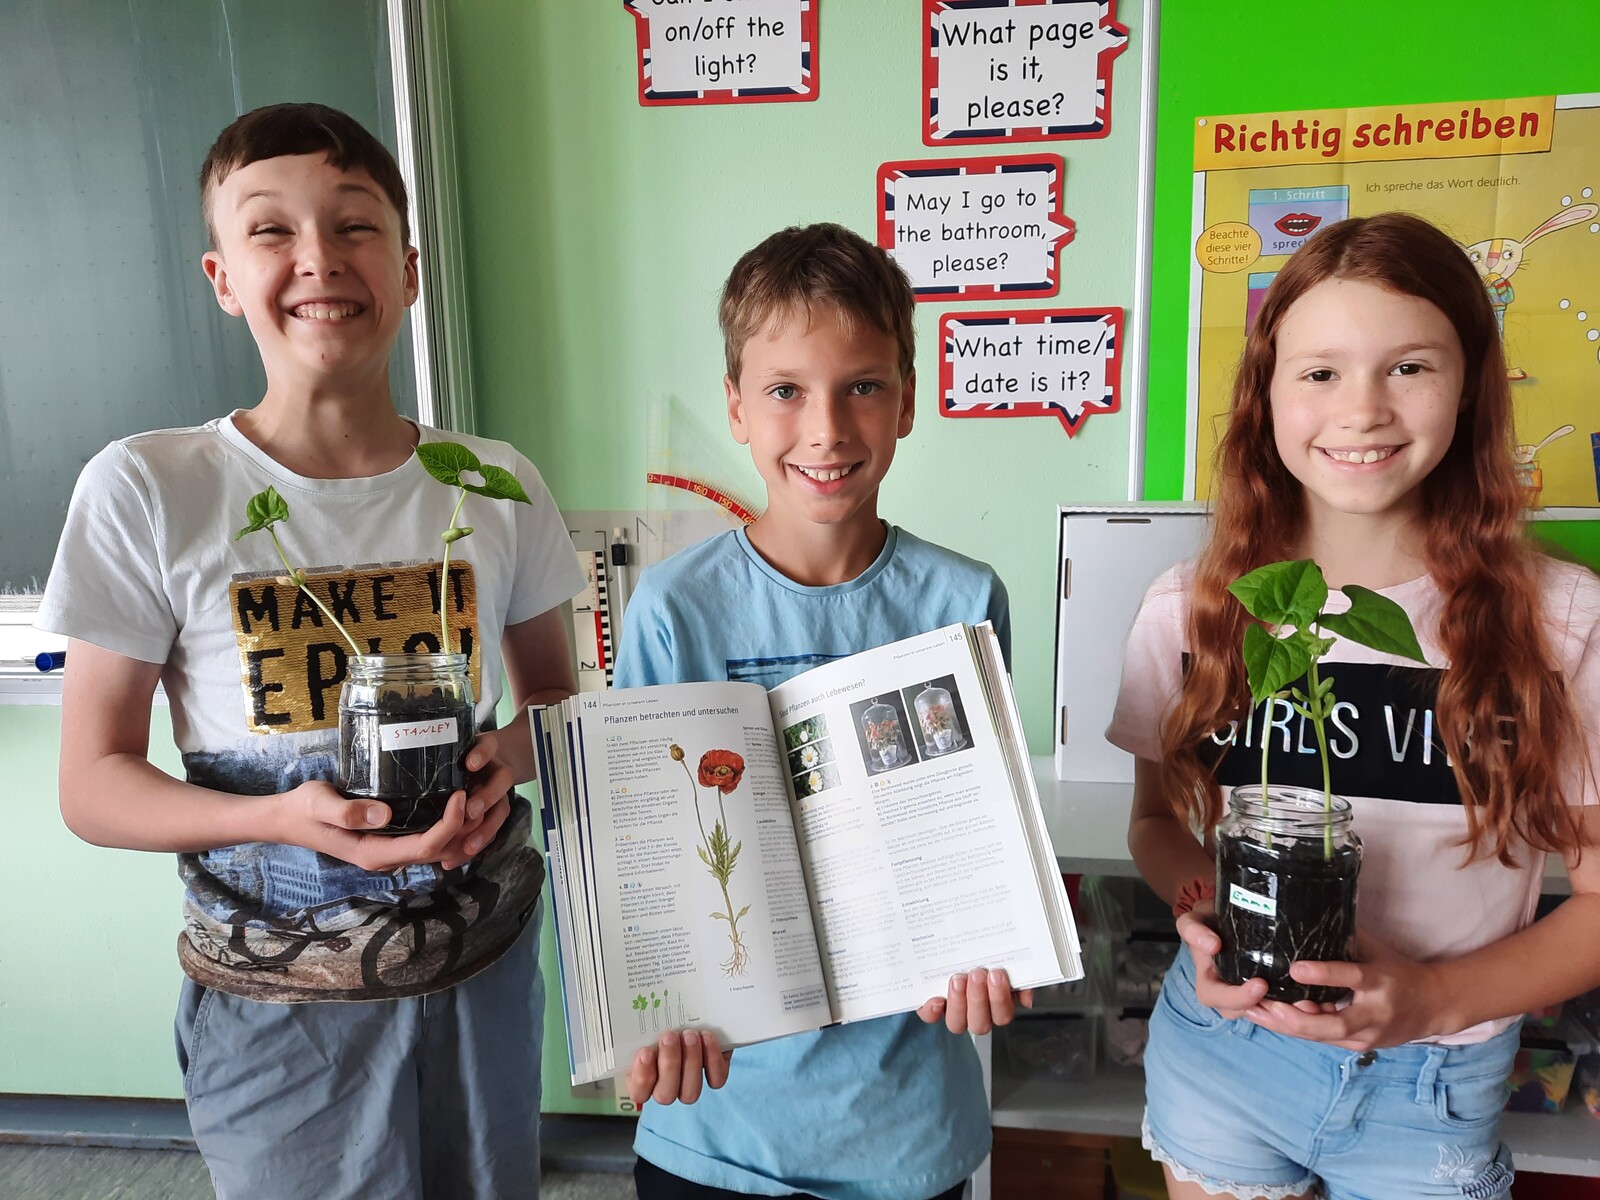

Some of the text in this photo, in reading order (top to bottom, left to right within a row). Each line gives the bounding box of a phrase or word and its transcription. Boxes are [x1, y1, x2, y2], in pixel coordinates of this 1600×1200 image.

[665, 16, 785, 41] on/off the
[942, 20, 1095, 48] What page
[695, 53, 757, 82] light?
[989, 57, 1044, 83] is it,
[967, 93, 1065, 126] please?
[1214, 108, 1539, 157] Richtig schreiben
[1273, 190, 1326, 200] 1. Schritt
[1366, 176, 1520, 193] Ich spreche das Wort deutlich.
[906, 188, 1037, 215] May I go to
[897, 222, 1048, 242] the bathroom,
[1210, 230, 1250, 240] Beachte
[1273, 238, 1307, 250] sprec
[1206, 242, 1252, 253] diese vier
[932, 252, 1008, 278] please?
[1208, 255, 1249, 266] Schritte!
[954, 330, 1106, 358] What time/
[965, 370, 1090, 394] date is it?
[693, 484, 708, 496] 160
[718, 496, 733, 509] 150
[238, 576, 397, 633] MAKE
[949, 632, 963, 642] 145
[583, 701, 597, 709] 144
[789, 699, 810, 713] Pflanzen
[826, 678, 866, 698] Lebewesen?
[604, 706, 739, 725] Pflanzen betrachten und untersuchen
[394, 722, 450, 739] STANLEY
[1233, 891, 1273, 910] Emma
